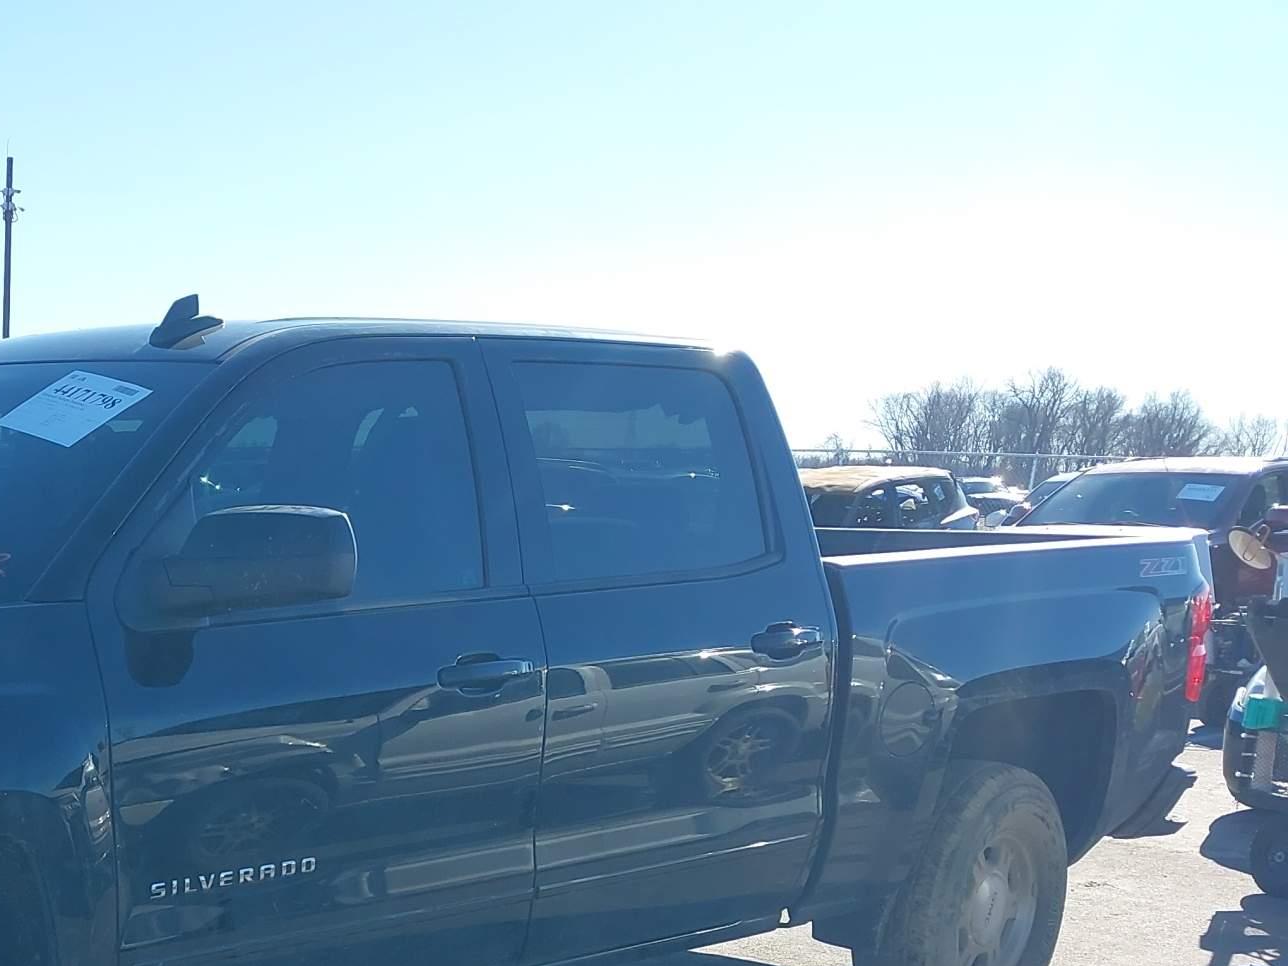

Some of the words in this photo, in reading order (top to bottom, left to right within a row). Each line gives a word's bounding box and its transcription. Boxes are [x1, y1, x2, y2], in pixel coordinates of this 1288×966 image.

[53, 383, 122, 410] 44171798
[1139, 556, 1188, 578] Z71
[150, 857, 316, 900] SILVERADO
